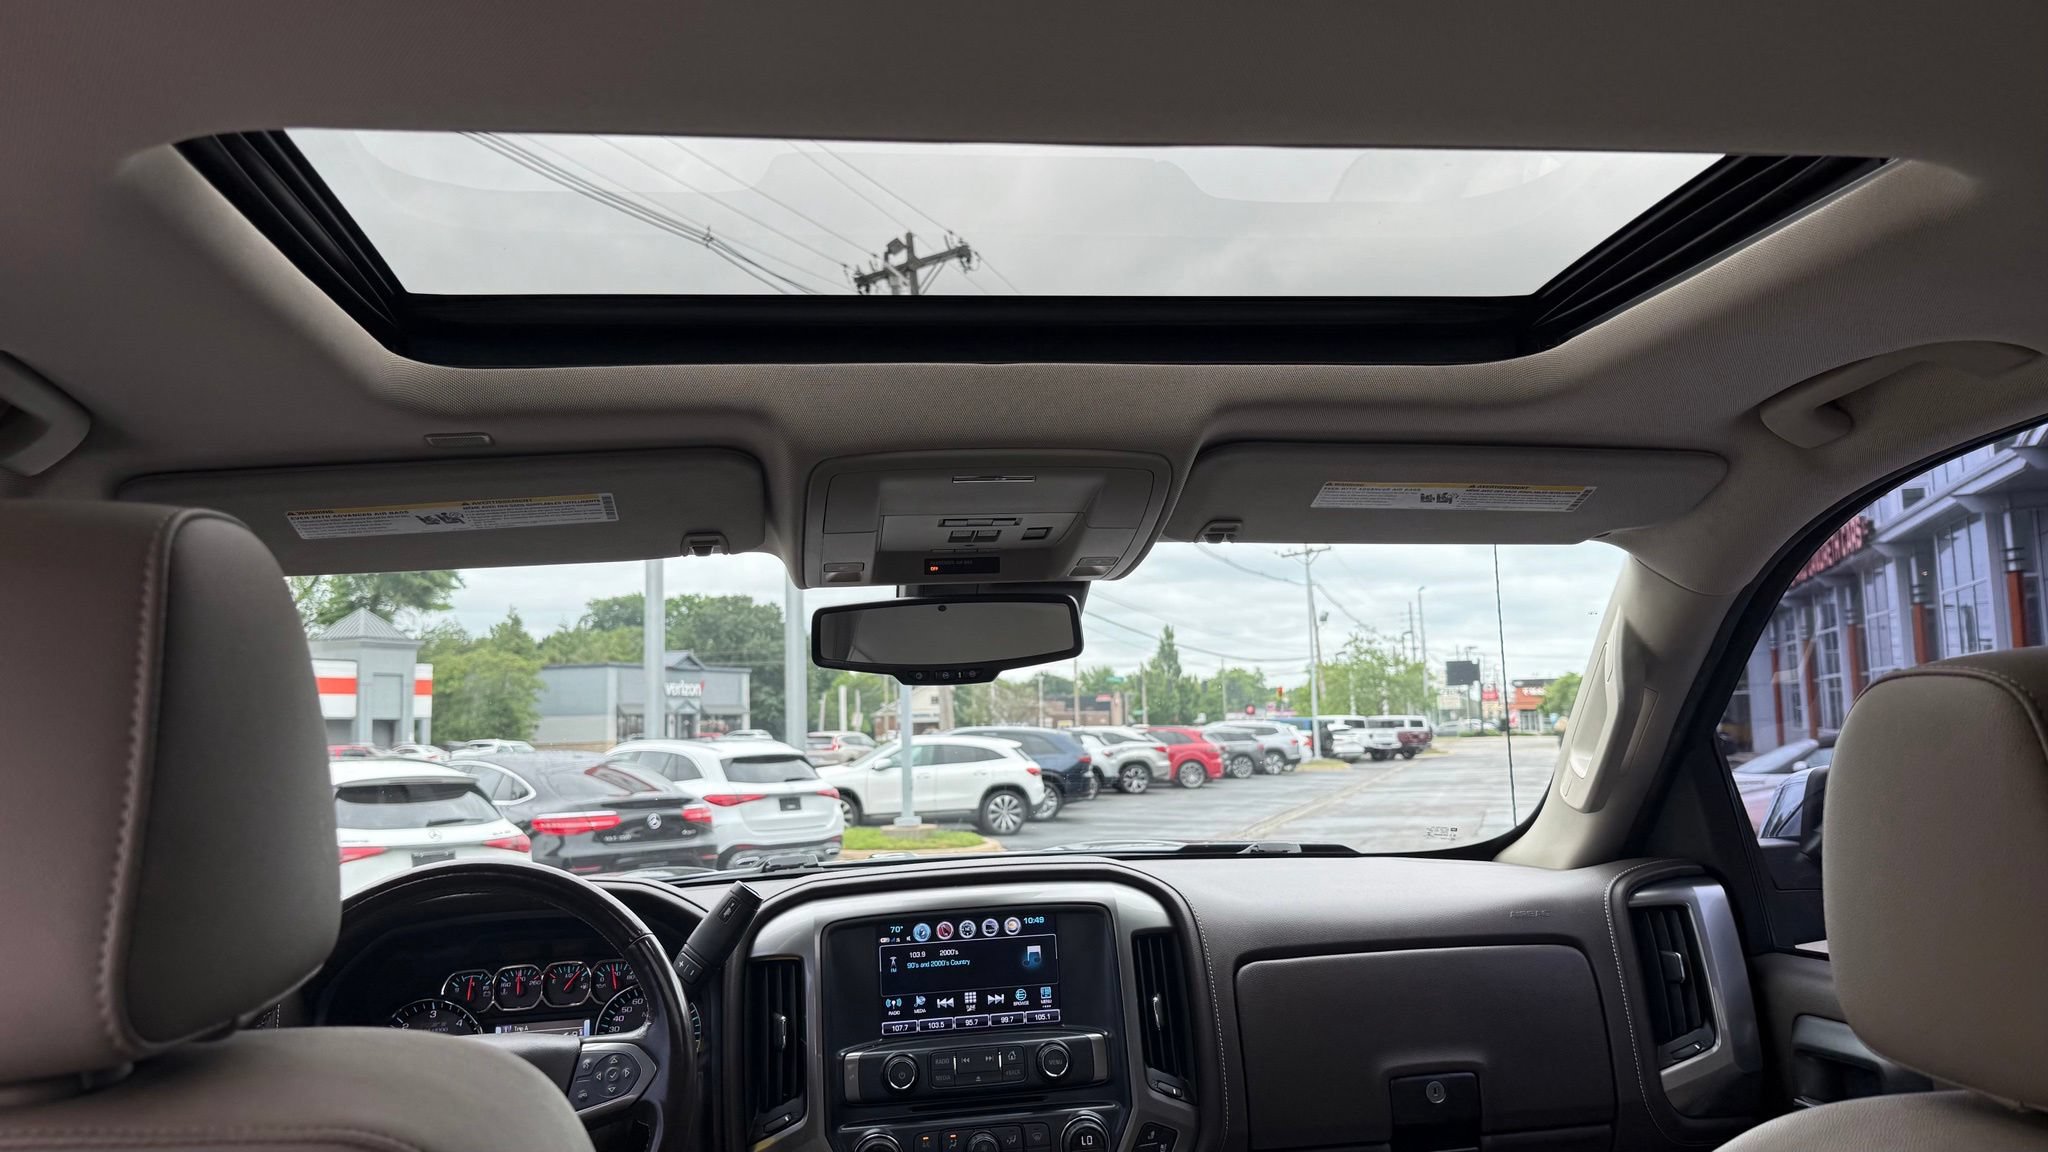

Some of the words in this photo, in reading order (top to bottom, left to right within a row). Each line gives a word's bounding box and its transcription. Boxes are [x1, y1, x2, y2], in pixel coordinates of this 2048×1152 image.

[664, 680, 702, 697] verizon
[1023, 916, 1045, 925] 10:49
[909, 951, 926, 959] 103.9
[939, 949, 959, 957] 2000's
[906, 961, 919, 969] 90's
[930, 959, 950, 967] 2000's
[950, 958, 971, 967] Country
[429, 1010, 437, 1019] 3
[1034, 1013, 1051, 1021] 105.1
[455, 1019, 463, 1027] 4
[965, 1018, 979, 1026] 95.7
[1000, 1016, 1014, 1024] 99.7
[891, 1024, 909, 1032] 107.7
[927, 1021, 945, 1029] 103.5
[1081, 1135, 1093, 1146] LO
